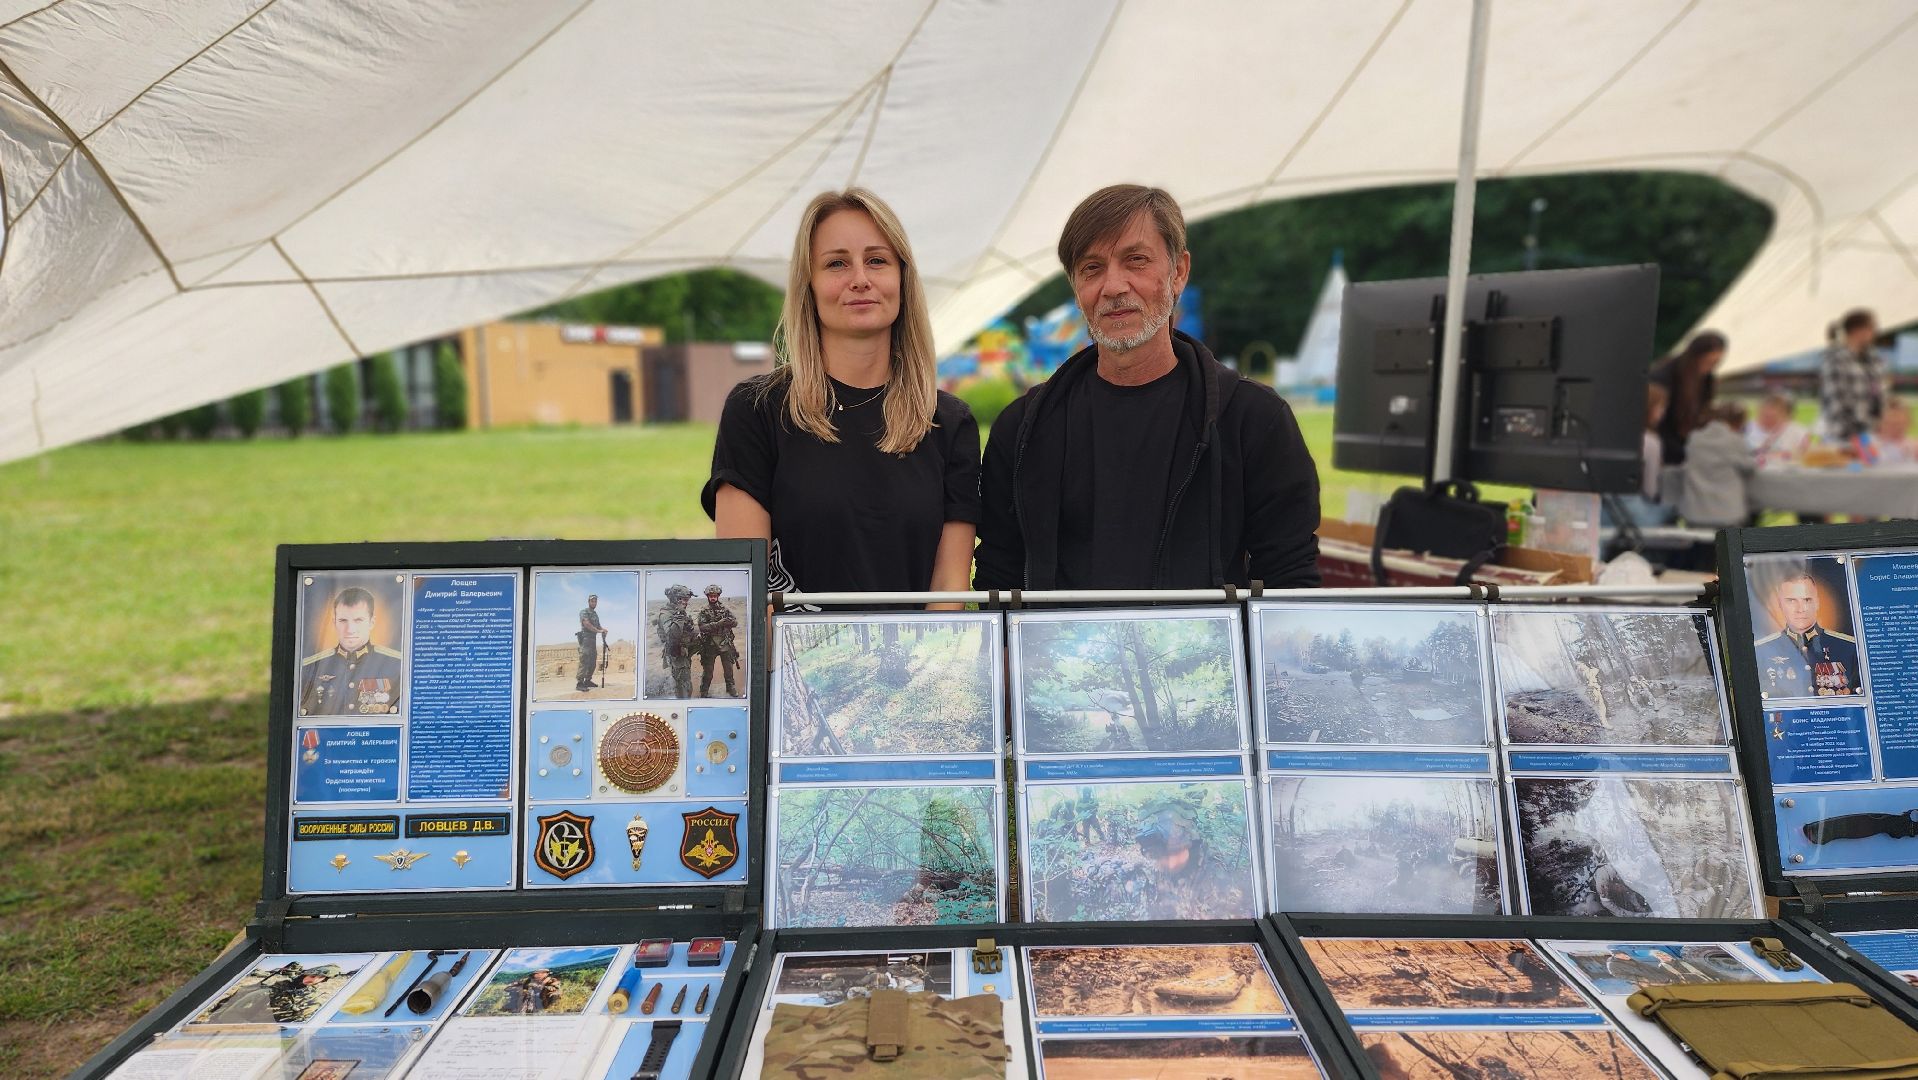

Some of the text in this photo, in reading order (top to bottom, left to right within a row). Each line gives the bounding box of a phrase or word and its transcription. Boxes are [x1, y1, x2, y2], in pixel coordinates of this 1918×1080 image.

[424, 590, 503, 598] Дмитрий Валерьевич
[326, 738, 356, 746] ДМИТРИЙ
[419, 821, 495, 832] ЛОВЦЕВ Д.В.
[690, 818, 730, 827] РОССИЯ
[300, 823, 394, 835] ВООРУЖЕННЫЕ СИЛЫ РОССИИ
